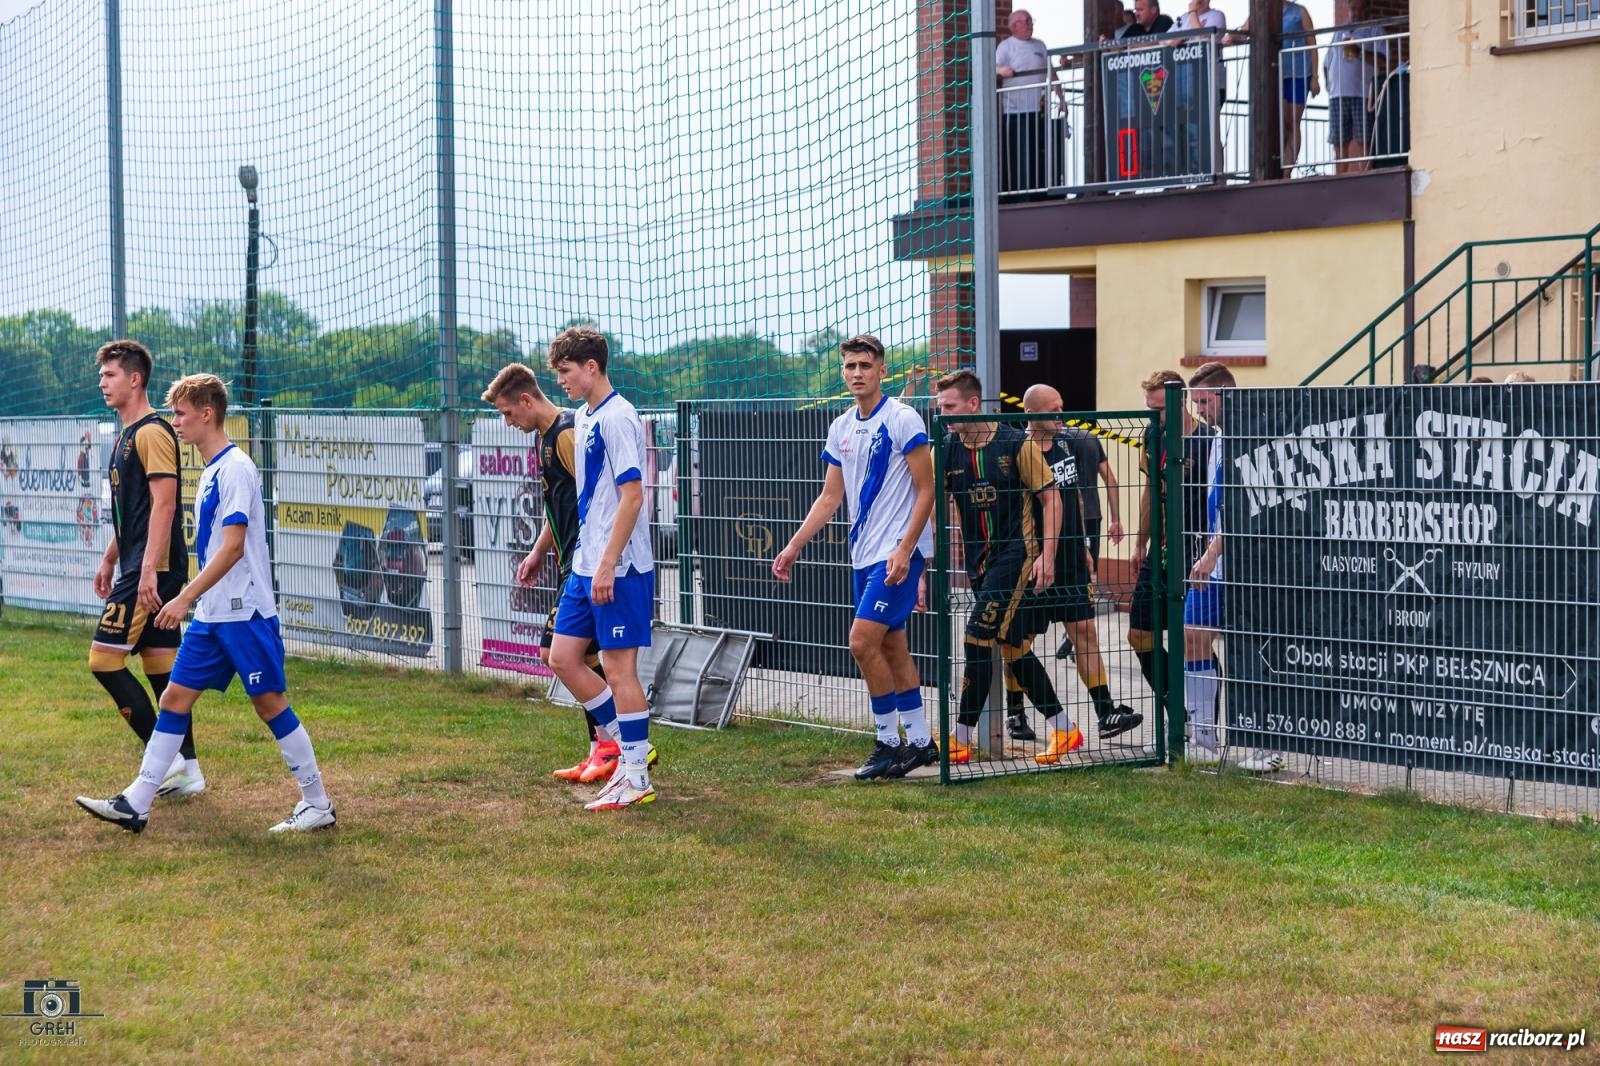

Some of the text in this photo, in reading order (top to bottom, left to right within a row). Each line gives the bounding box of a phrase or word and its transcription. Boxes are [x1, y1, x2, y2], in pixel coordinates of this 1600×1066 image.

[1107, 51, 1162, 71] GOSPODARZE
[284, 423, 376, 461] MECHANIKA
[480, 447, 522, 476] salon
[1234, 410, 1600, 527] MĘSKA STACJA
[326, 461, 421, 502] POJAZDOWA
[480, 493, 541, 547] VIS
[1324, 500, 1497, 545] BARBERSHOP
[1321, 555, 1376, 574] KLASYCZNE
[1452, 560, 1500, 580] FRYZURY
[100, 602, 126, 628] 21
[1388, 609, 1431, 628] I BRODY
[510, 622, 545, 641] Gorzyc
[1286, 644, 1546, 687] Obok stacji PKP BEŁSZNICA
[1237, 712, 1262, 730] tel.
[1267, 713, 1294, 733] 576
[1298, 717, 1331, 738] 090
[1334, 720, 1367, 741] 888
[1411, 701, 1486, 728] WIZYTĘ
